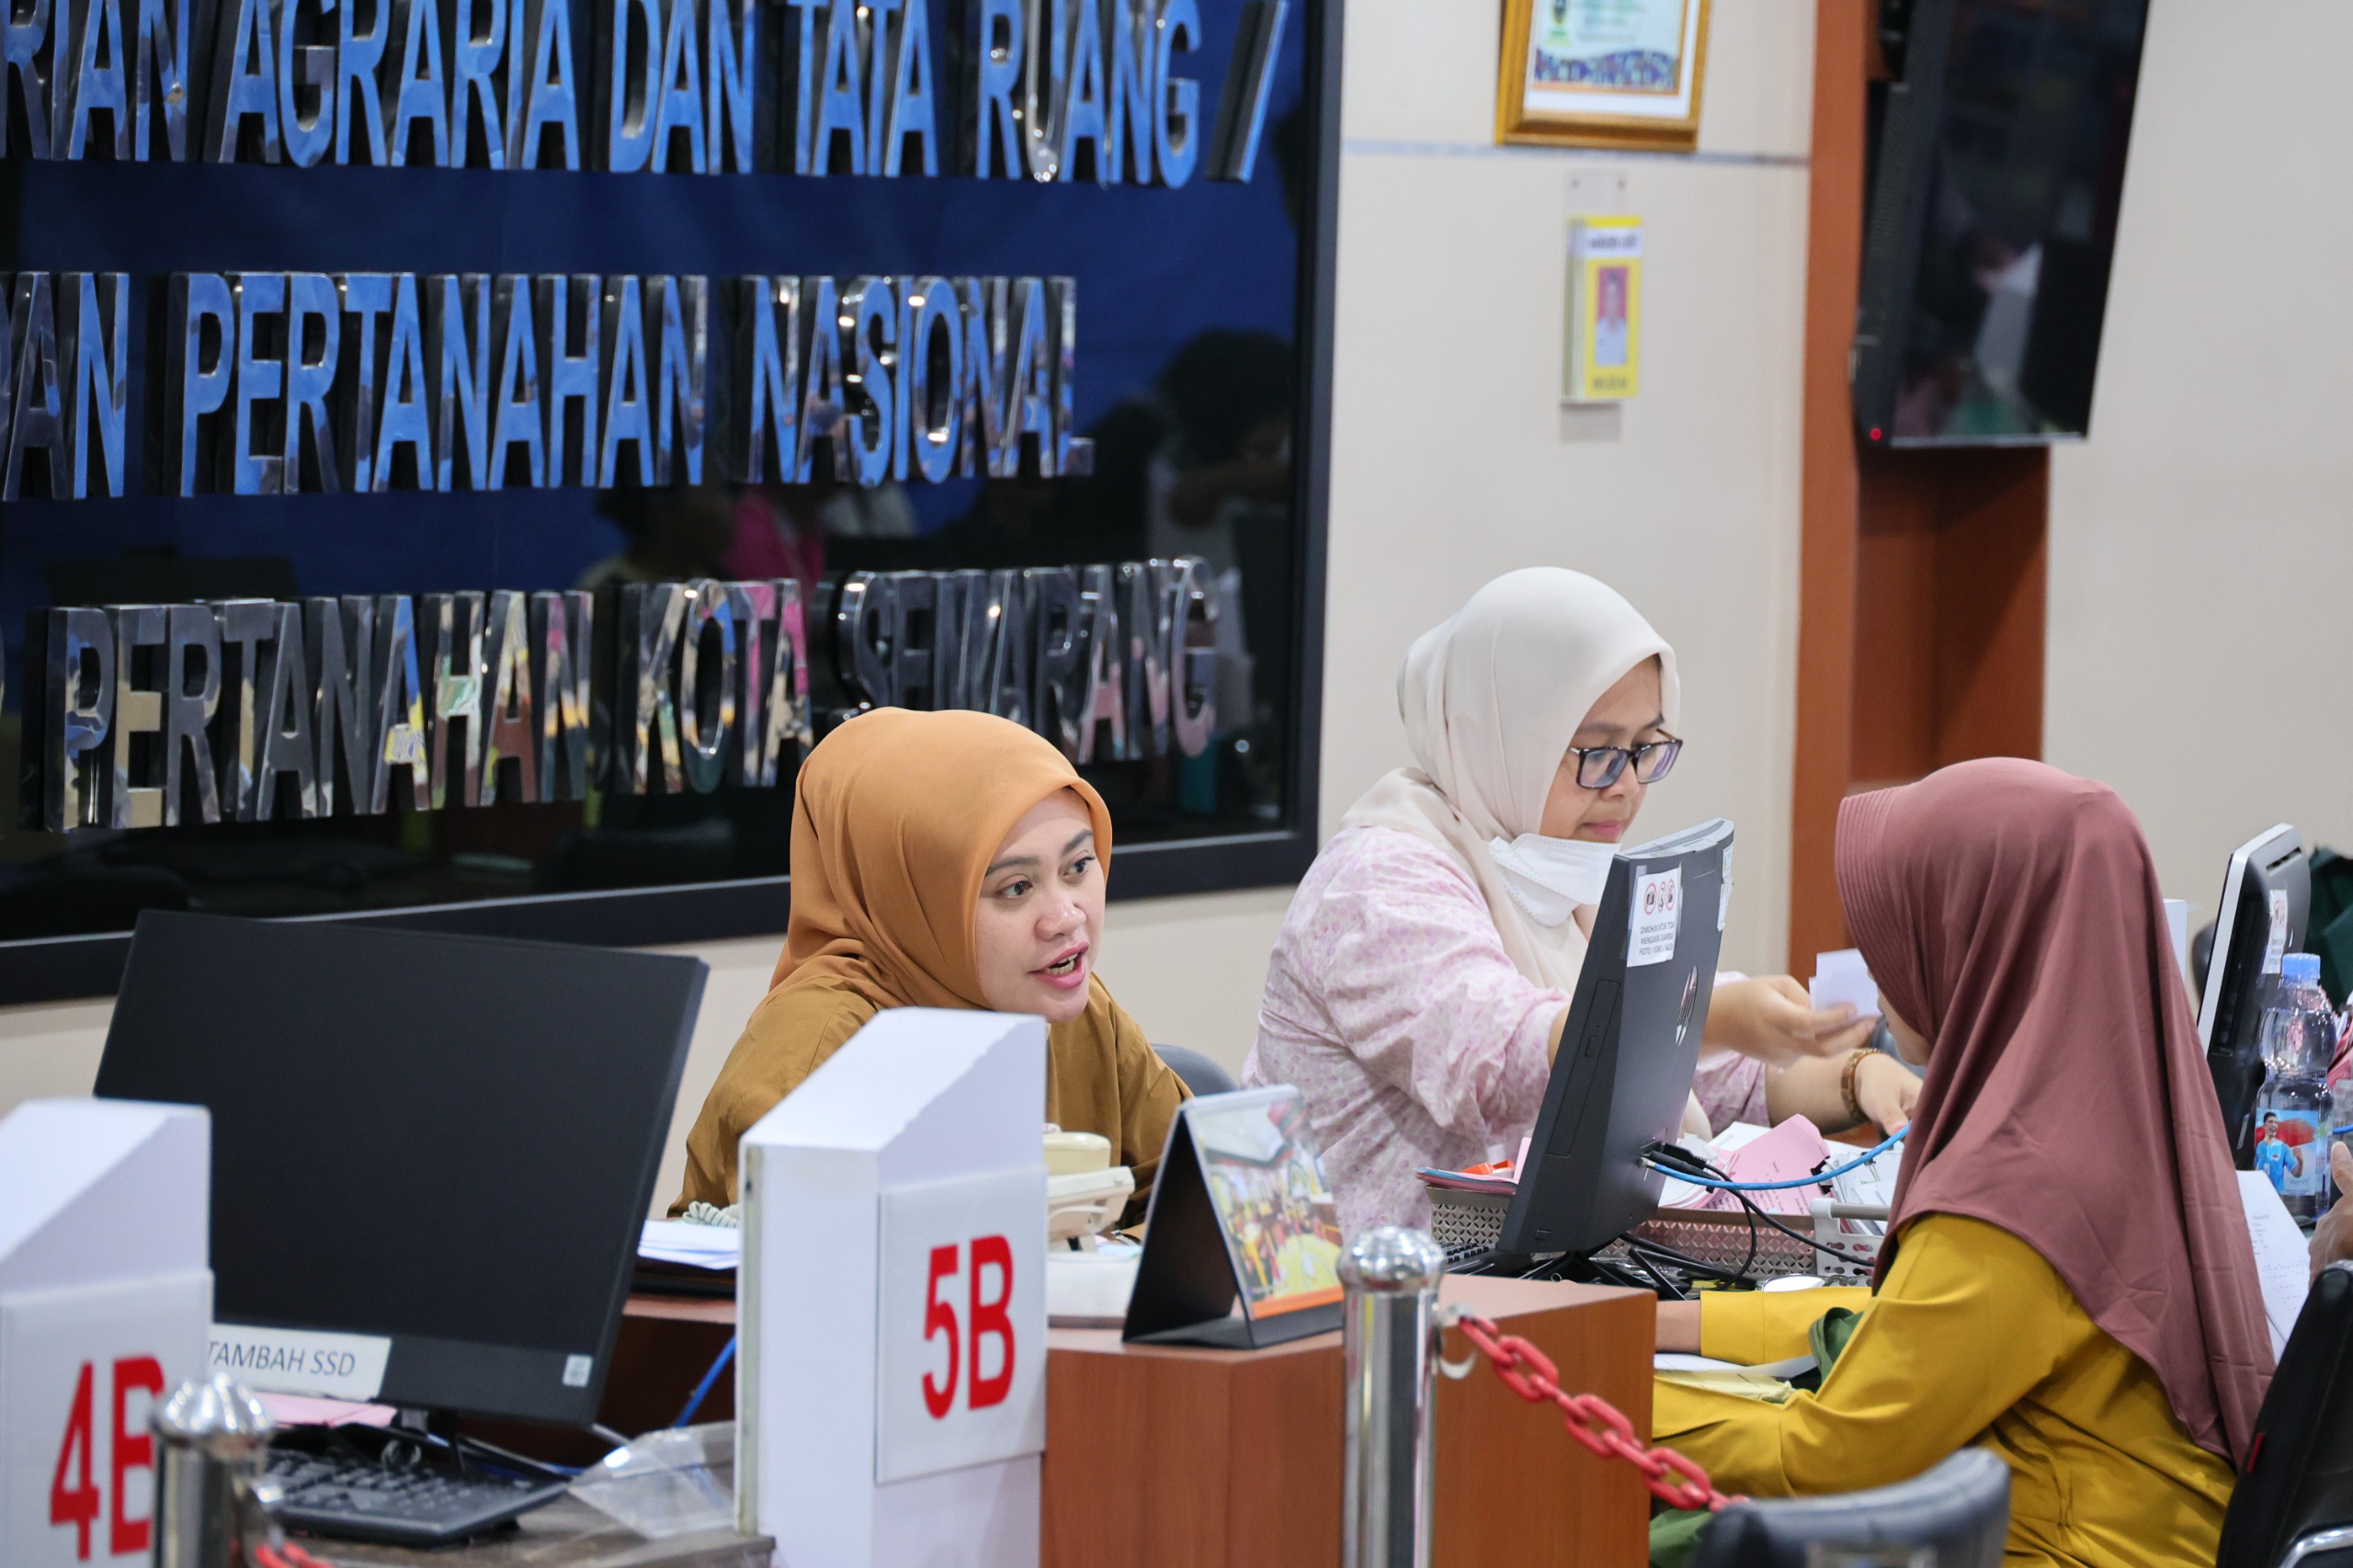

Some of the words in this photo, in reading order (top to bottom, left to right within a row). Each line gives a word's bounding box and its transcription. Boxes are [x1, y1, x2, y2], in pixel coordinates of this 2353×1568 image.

[219, 0, 581, 169] AGRARIA
[607, 0, 754, 176] DAN
[787, 0, 939, 177] TATA
[974, 0, 1201, 189] RUANG
[0, 271, 130, 502] AN
[178, 270, 708, 497] PERTANAHAN
[743, 275, 1096, 488] NASIONAL
[53, 589, 594, 833] PERTANAHAN
[624, 577, 813, 794] KOTA
[209, 1341, 306, 1373] TAMBAH
[310, 1349, 356, 1378] SSD
[922, 1233, 1017, 1420] 5B
